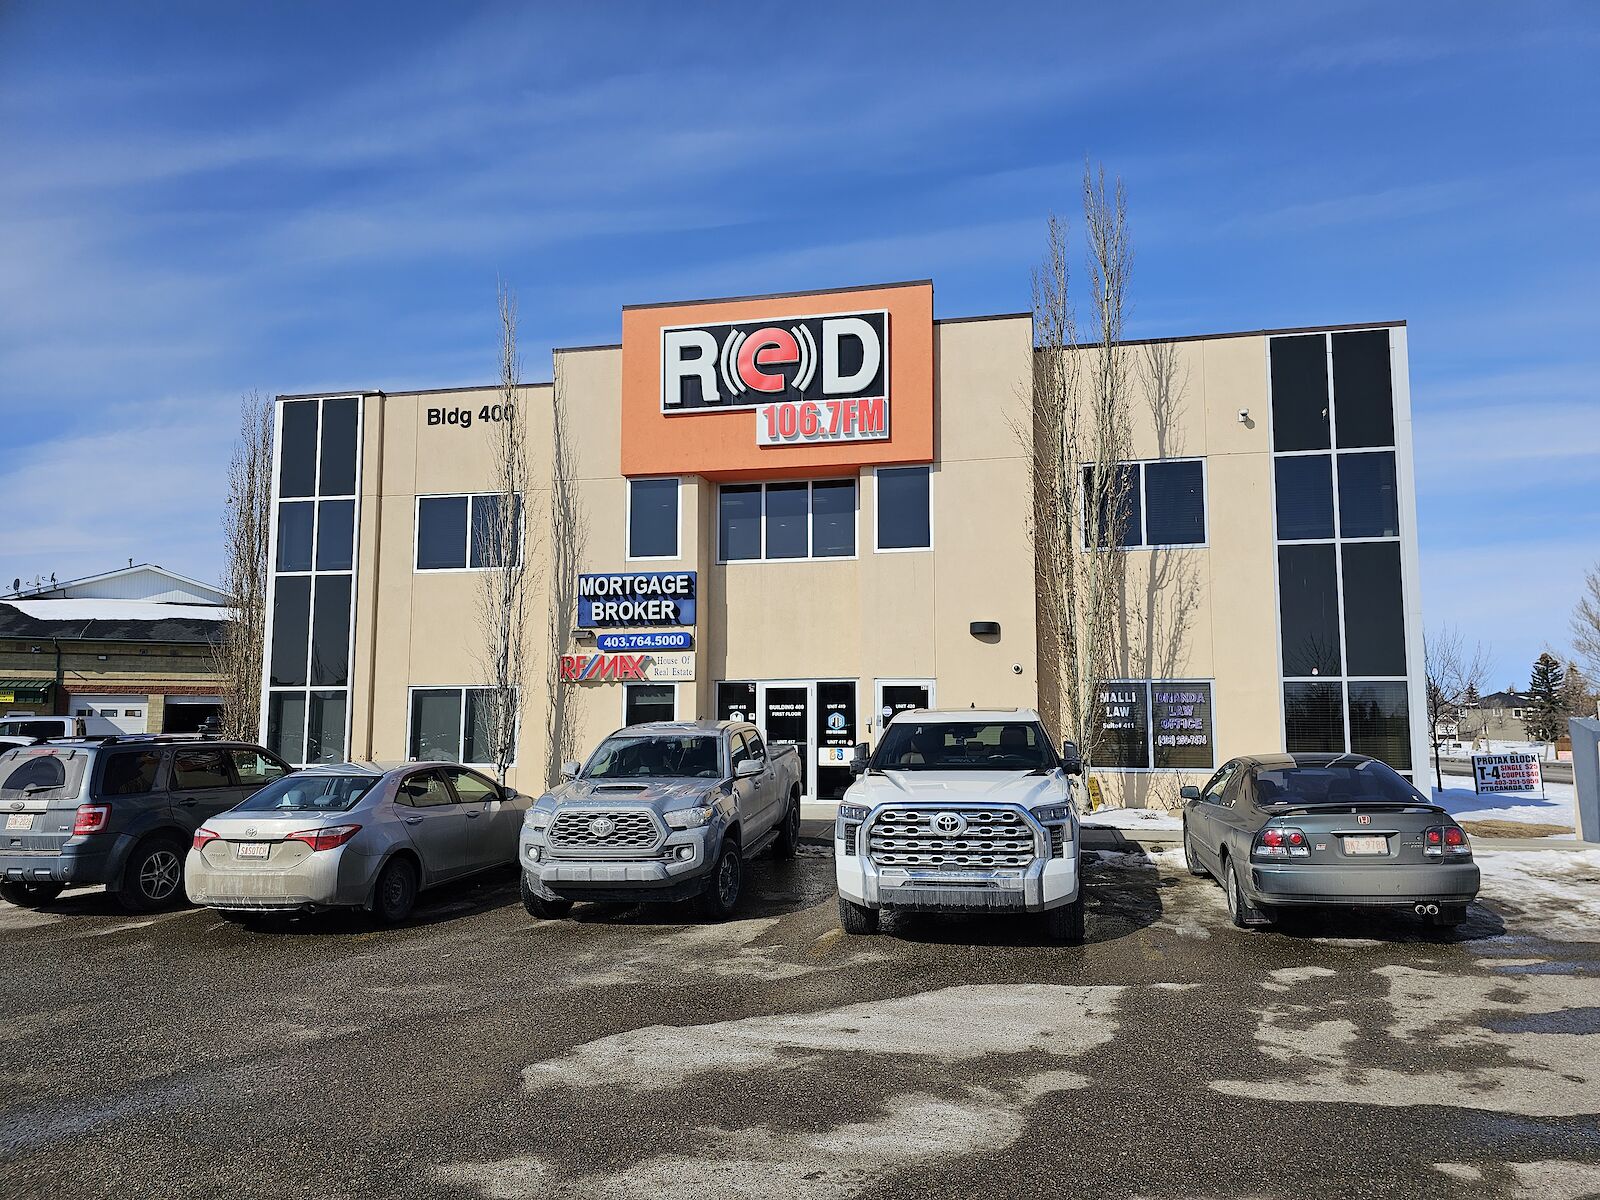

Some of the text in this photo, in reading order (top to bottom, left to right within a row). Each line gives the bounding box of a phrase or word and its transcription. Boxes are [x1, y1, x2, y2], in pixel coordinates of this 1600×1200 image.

[427, 404, 515, 428] Bldg 400
[762, 398, 884, 437] 106.7FM
[579, 574, 689, 596] MORTGAGE
[591, 600, 676, 621] BROKER
[603, 635, 685, 647] 403.764.5000
[657, 655, 691, 665] House Of
[560, 653, 646, 681] RE/MAX
[654, 667, 693, 676] Real Estate
[1105, 706, 1130, 717] LAW
[1168, 705, 1194, 716] LAW
[1160, 718, 1203, 729] OFFICE
[1476, 754, 1537, 766] PROTAX BLOCK
[1477, 766, 1501, 780] T-4
[1501, 771, 1525, 779] COUPLE
[1480, 784, 1535, 792] PTBCANADA.CA
